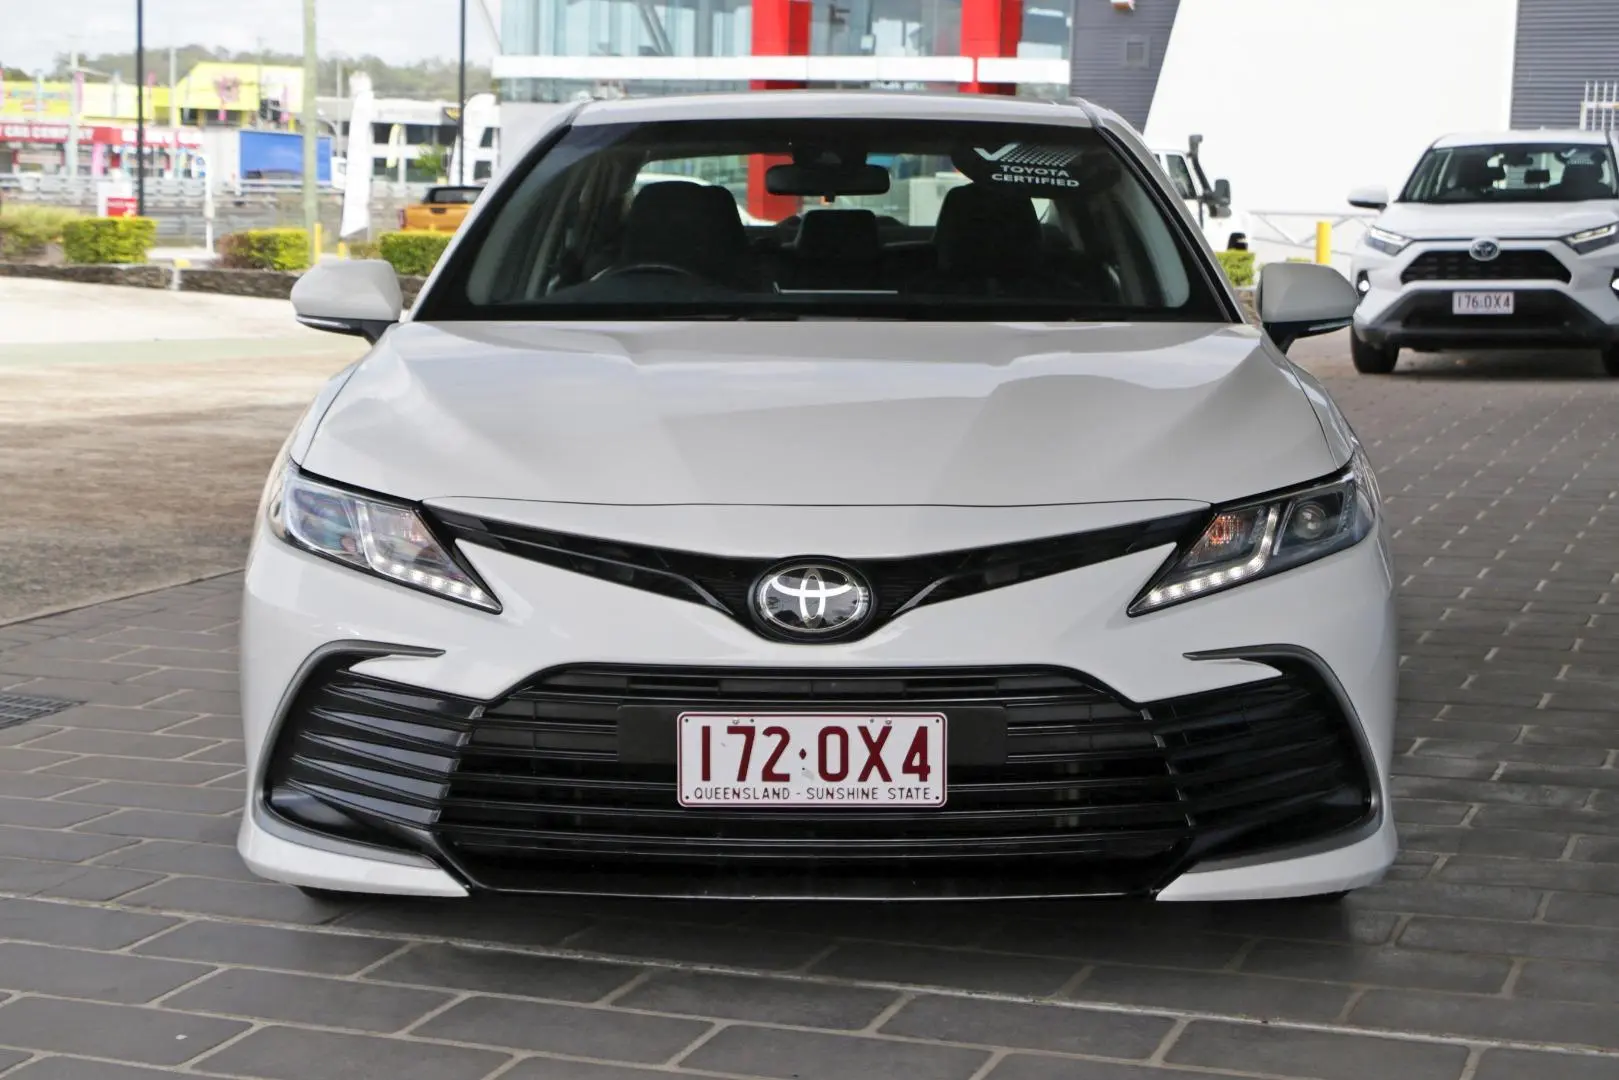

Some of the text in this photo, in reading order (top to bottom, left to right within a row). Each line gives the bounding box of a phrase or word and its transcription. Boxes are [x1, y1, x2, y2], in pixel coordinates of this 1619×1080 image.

[1000, 165, 1070, 177] TOYOTA
[991, 173, 1080, 187] CERTIFIED
[694, 787, 790, 800] QUEENSLAND
[806, 787, 879, 800] SUNSHINE
[888, 787, 931, 800] STATE
